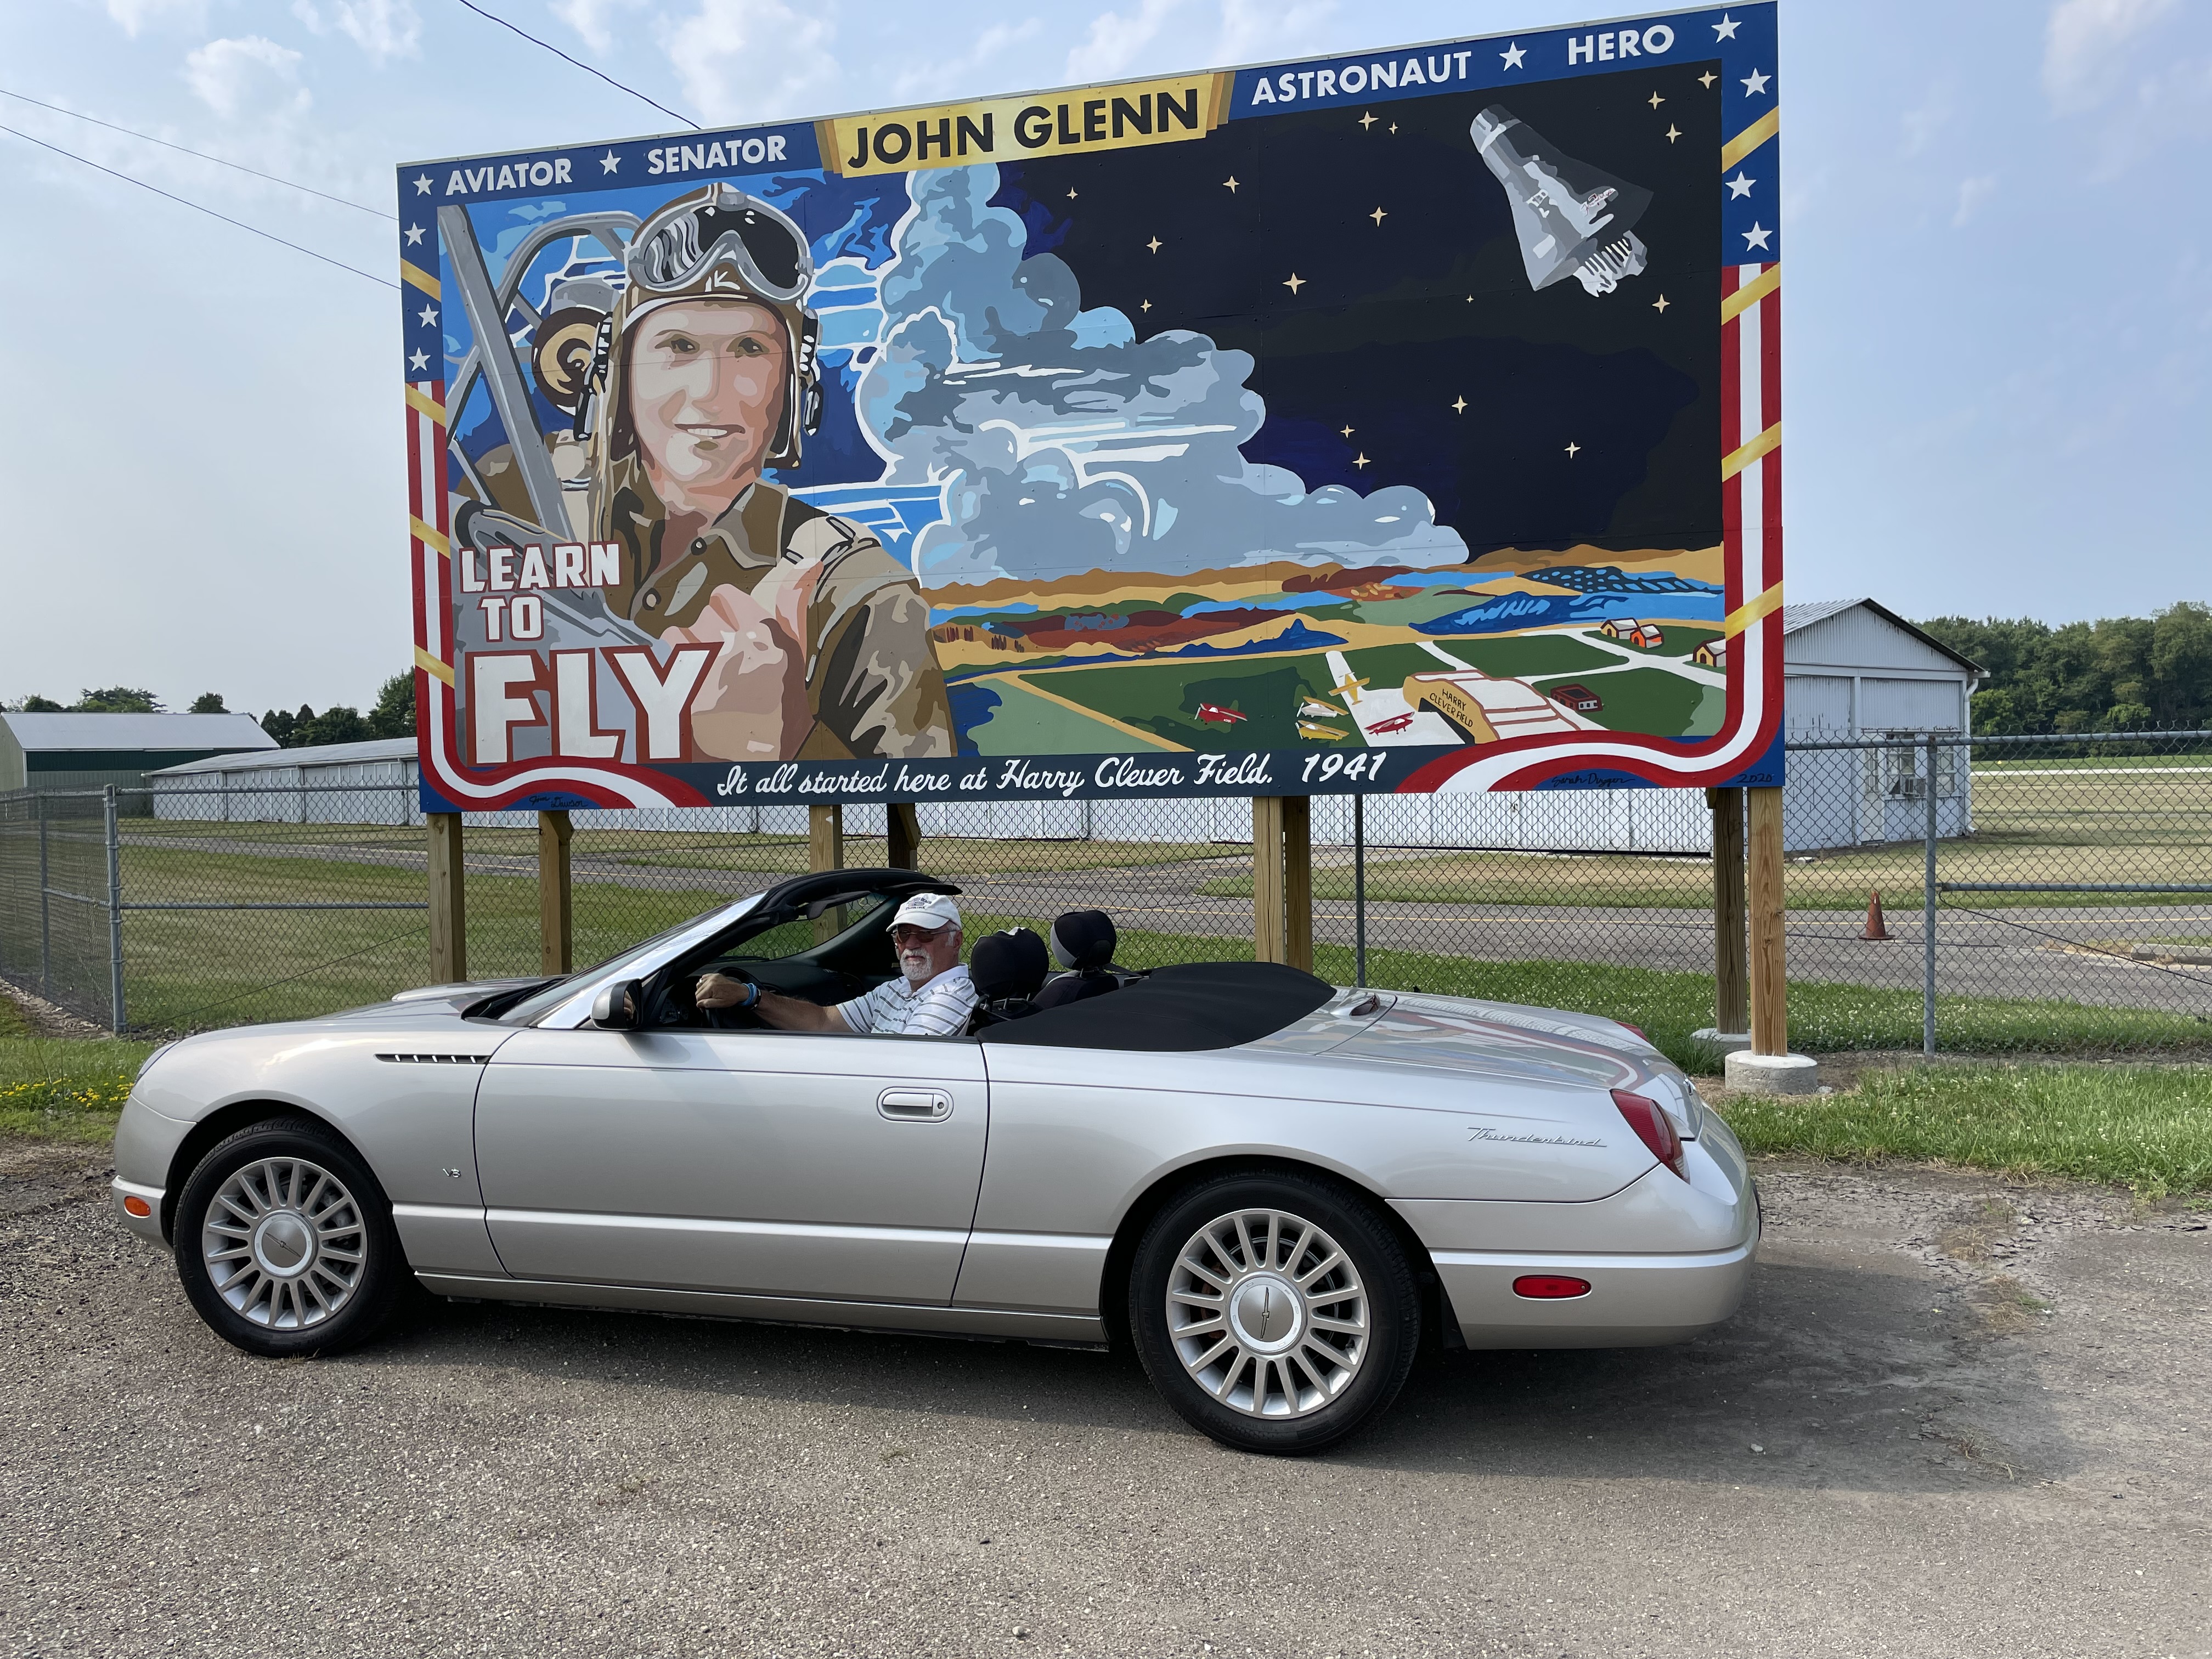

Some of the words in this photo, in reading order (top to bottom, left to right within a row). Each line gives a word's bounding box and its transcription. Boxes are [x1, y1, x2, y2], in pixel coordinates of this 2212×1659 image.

[1567, 24, 1674, 65] HERO
[1251, 50, 1472, 105] ASTRONAUT
[847, 112, 994, 169] JOHN
[1014, 88, 1198, 149] GLENN
[647, 135, 787, 175] SENATOR
[445, 158, 573, 196] AVIATOR
[460, 542, 620, 593] LEARN
[479, 596, 543, 640] TO
[470, 647, 715, 764] FLY
[1430, 693, 1456, 716] CLEVER
[1456, 710, 1473, 727] FIELD
[1442, 688, 1466, 711] HARRY
[717, 765, 748, 796] It
[755, 763, 798, 793] all
[798, 763, 887, 794] started
[893, 764, 952, 793] here
[960, 766, 988, 790] at
[996, 759, 1085, 797] Harry
[1094, 756, 1185, 788] Clever
[1193, 753, 1273, 785] Field.
[1301, 751, 1387, 783] 1941
[1551, 775, 1587, 788] Sarah
[1736, 772, 1773, 783] 2020
[1466, 1126, 1607, 1148] Thunderbird
